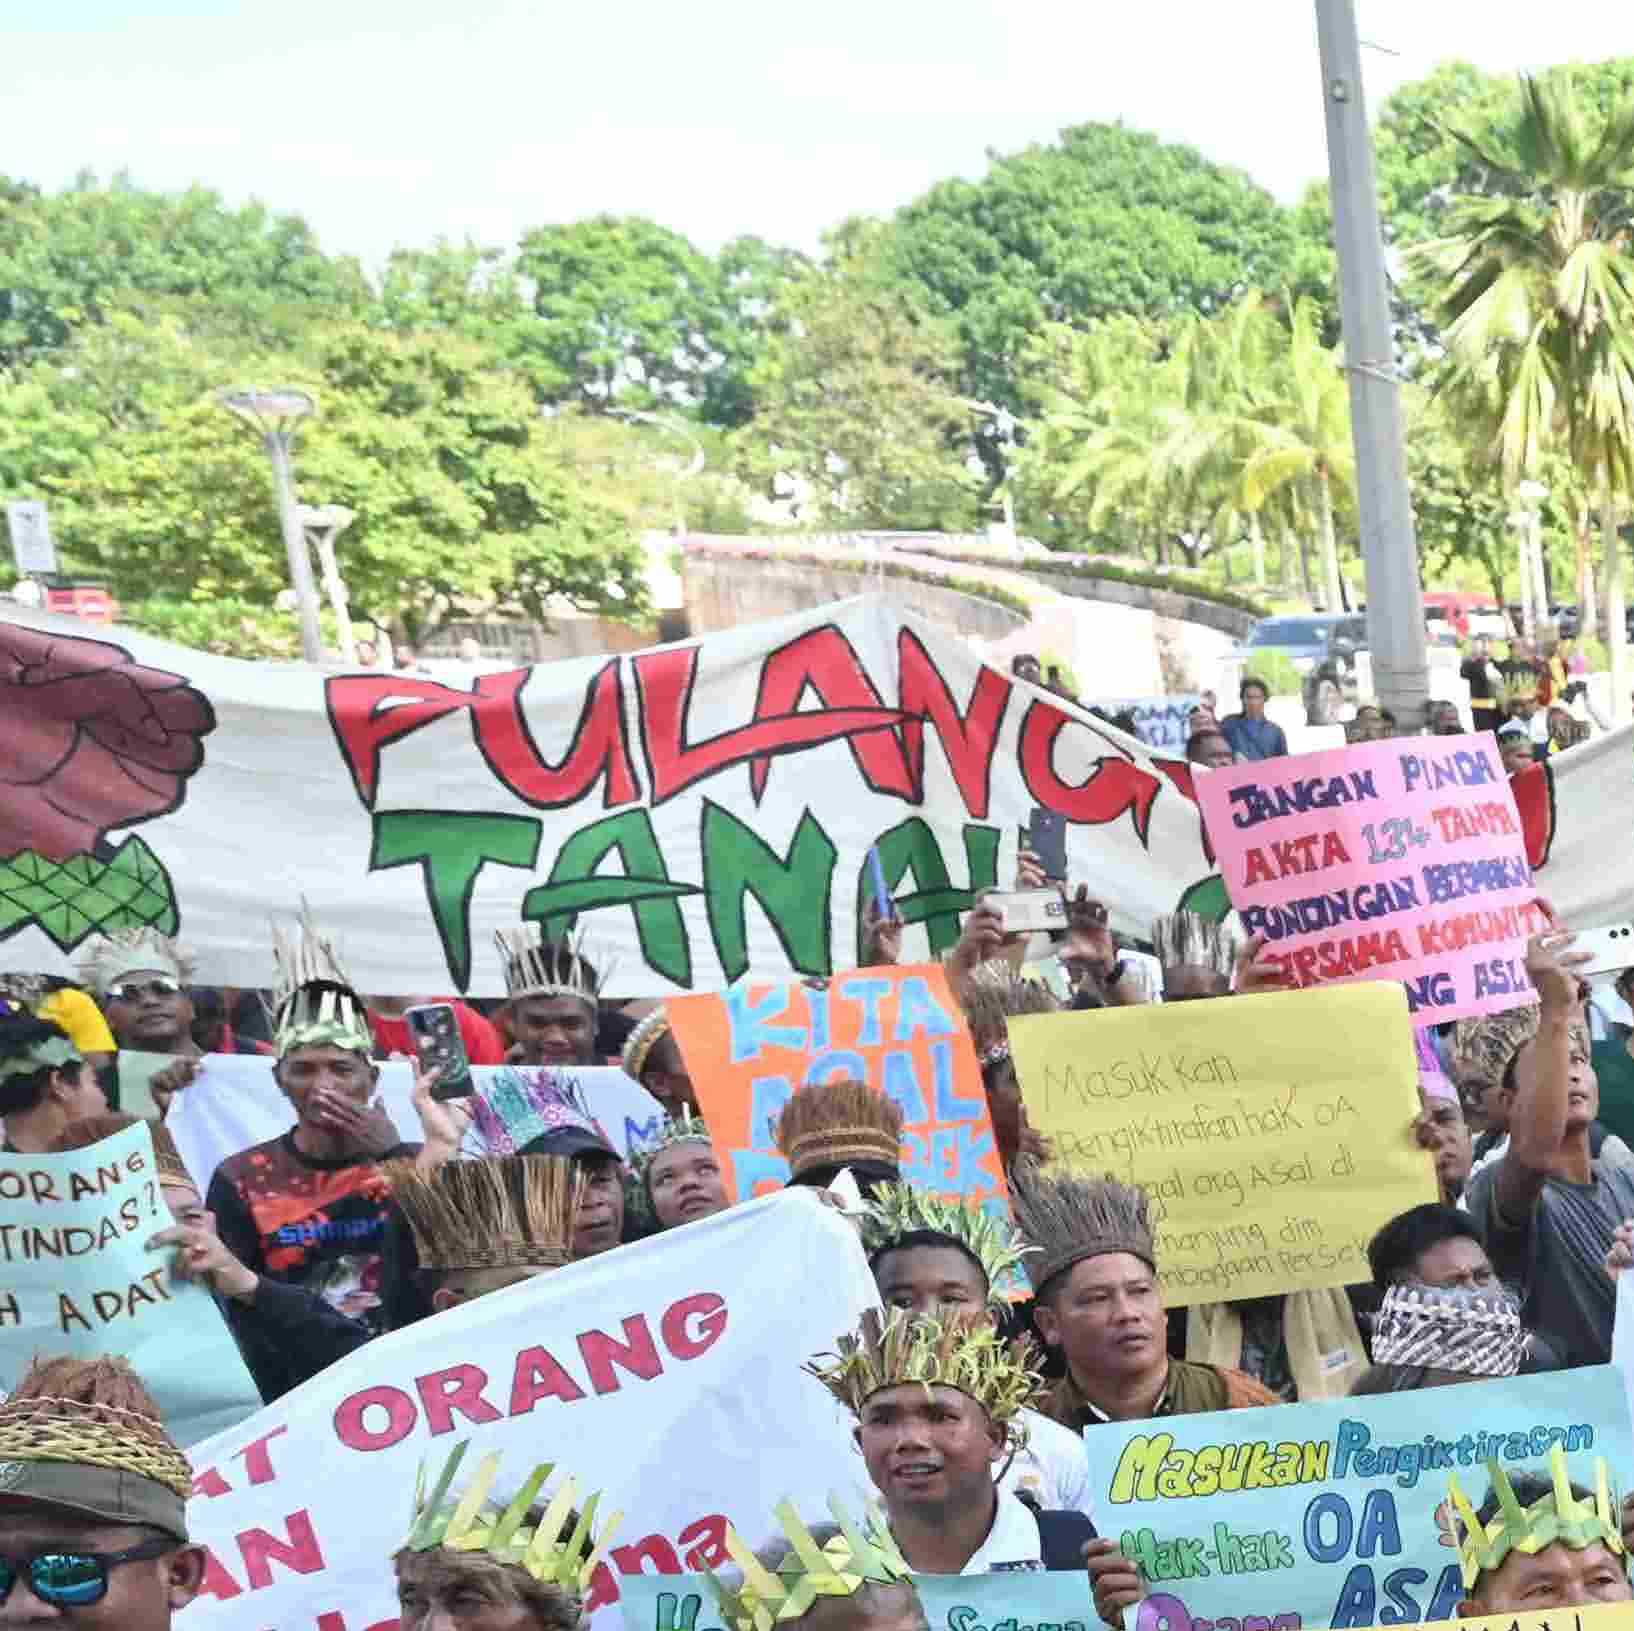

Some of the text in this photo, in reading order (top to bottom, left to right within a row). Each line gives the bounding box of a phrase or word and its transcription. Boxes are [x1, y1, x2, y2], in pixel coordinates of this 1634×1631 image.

[1229, 770, 1377, 829] JANGAN
[1243, 831, 1351, 887] AKTA
[724, 977, 958, 1065] KITA
[1405, 973, 1456, 1012] NG
[0, 1151, 145, 1204] ORANG
[59, 1269, 171, 1333] ADAT
[332, 1290, 730, 1453] ORANG
[1109, 1419, 1594, 1504] Masukan Pengiktirafan
[199, 1508, 327, 1602] AN
[1120, 1522, 1296, 1582] Hak-hak
[1303, 1489, 1402, 1564] OA
